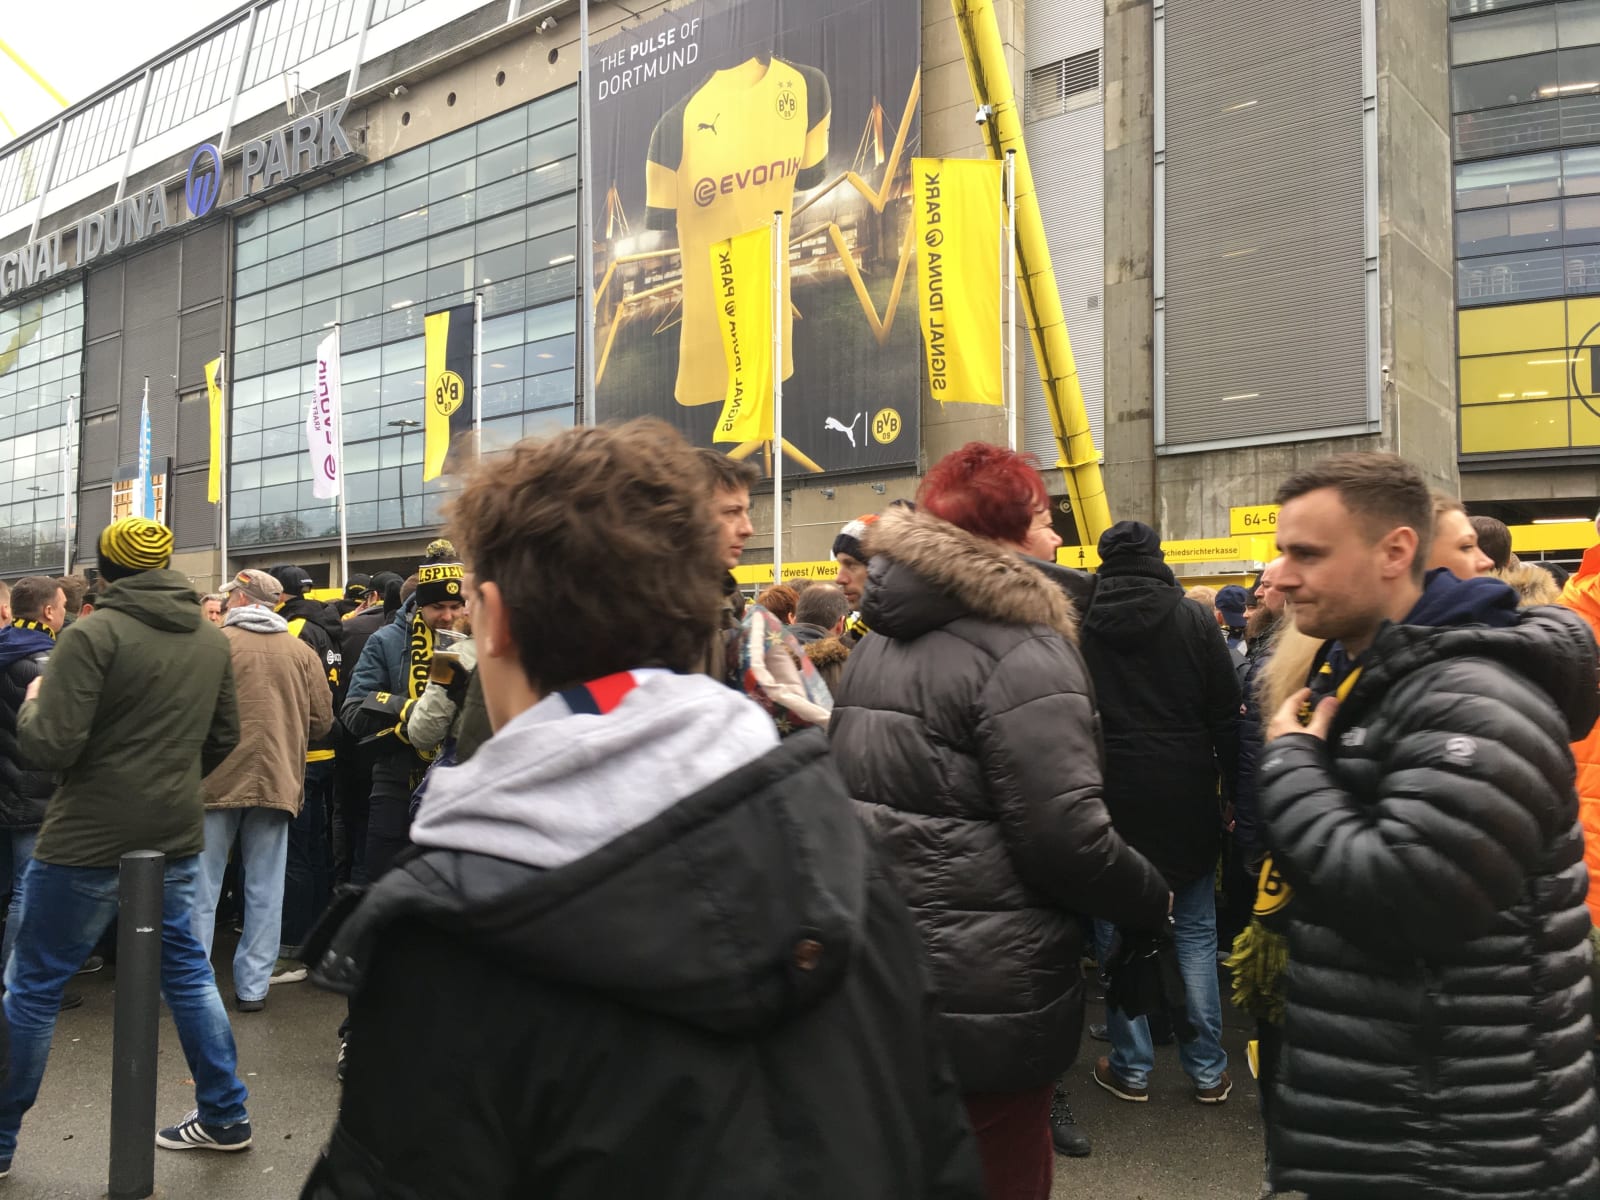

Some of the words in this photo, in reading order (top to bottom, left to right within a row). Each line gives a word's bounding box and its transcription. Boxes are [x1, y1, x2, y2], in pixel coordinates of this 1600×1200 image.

[600, 48, 626, 73] THE
[630, 27, 676, 61] PULSE
[680, 17, 700, 39] OF
[598, 43, 698, 101] DORTMUND
[778, 93, 795, 112] BVB
[76, 184, 169, 266] IDUNA
[242, 97, 354, 195] PARK
[876, 412, 898, 434] BVB
[882, 432, 891, 440] 09
[1244, 512, 1279, 526] 64-6
[769, 567, 809, 578] Nrdwest
[816, 566, 838, 576] West
